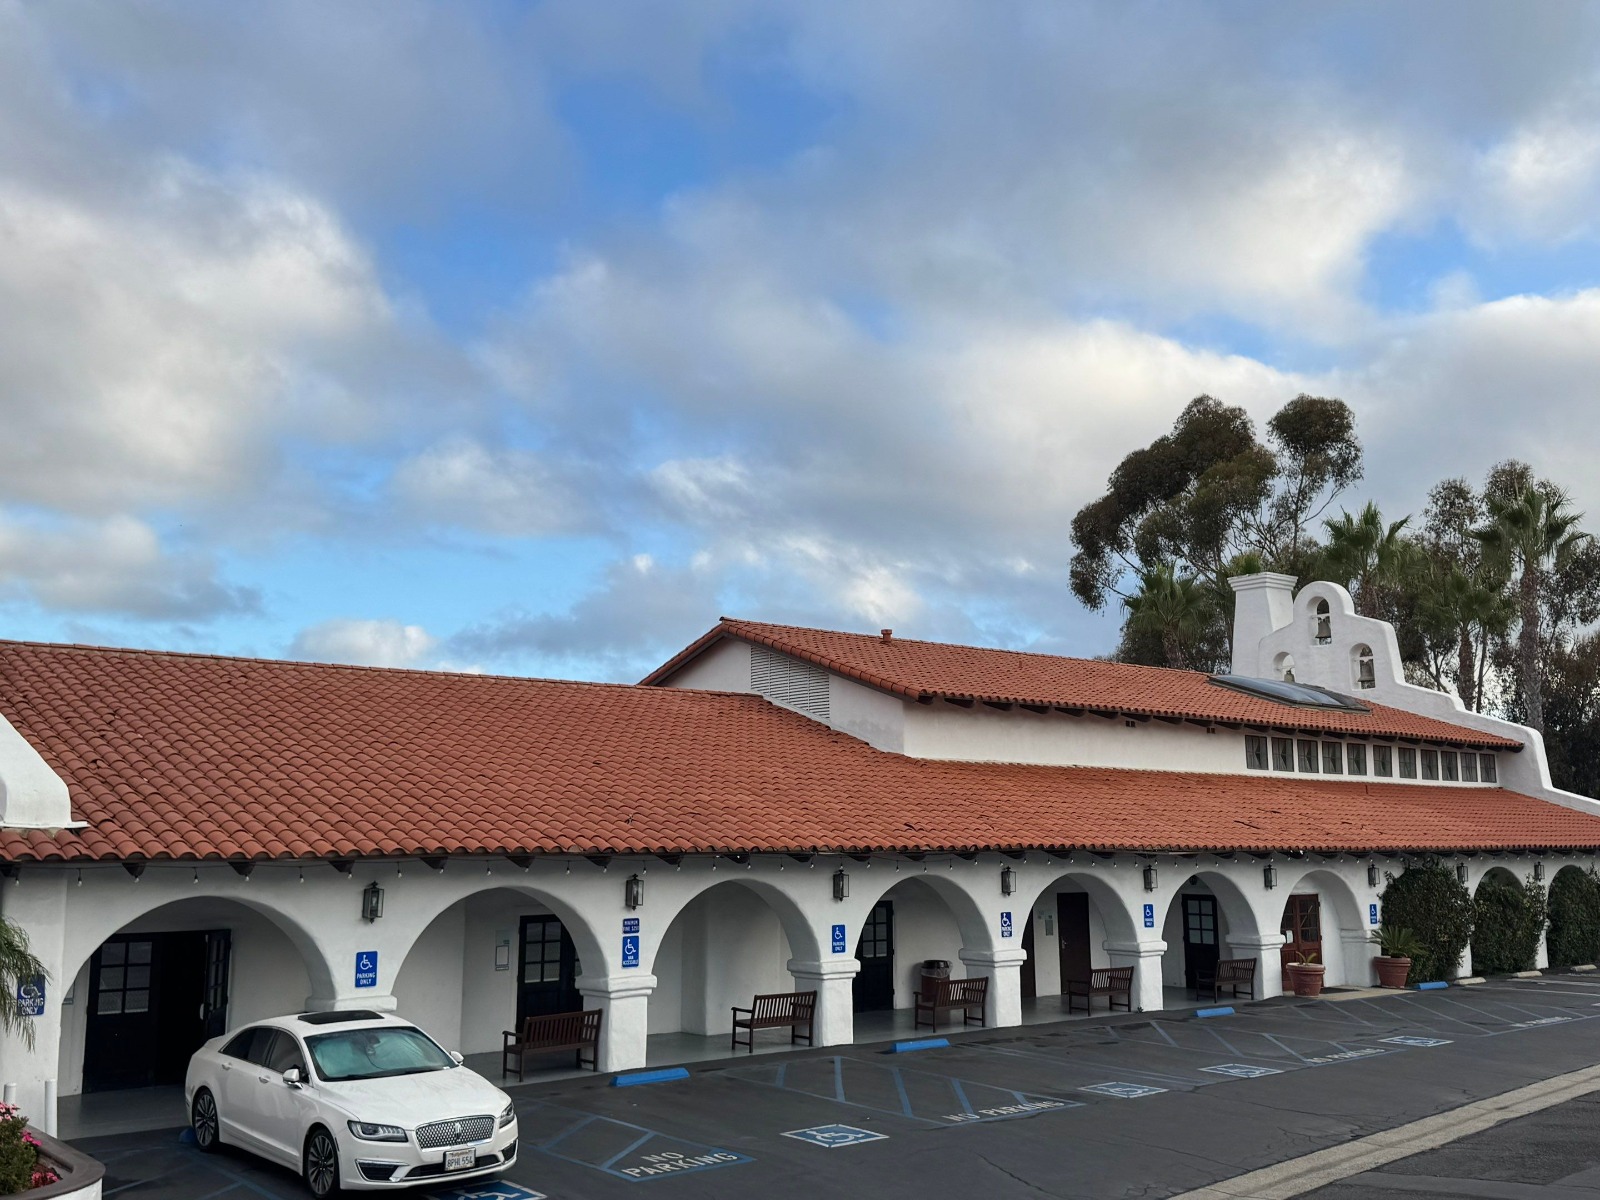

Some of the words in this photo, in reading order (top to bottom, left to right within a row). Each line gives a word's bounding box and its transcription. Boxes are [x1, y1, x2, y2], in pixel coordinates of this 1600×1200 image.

[21, 1006, 38, 1015] ONLY
[942, 1112, 980, 1122] NO
[978, 1101, 1064, 1116] PARKING
[622, 1152, 738, 1177] PARKING
[641, 1152, 684, 1162] NO
